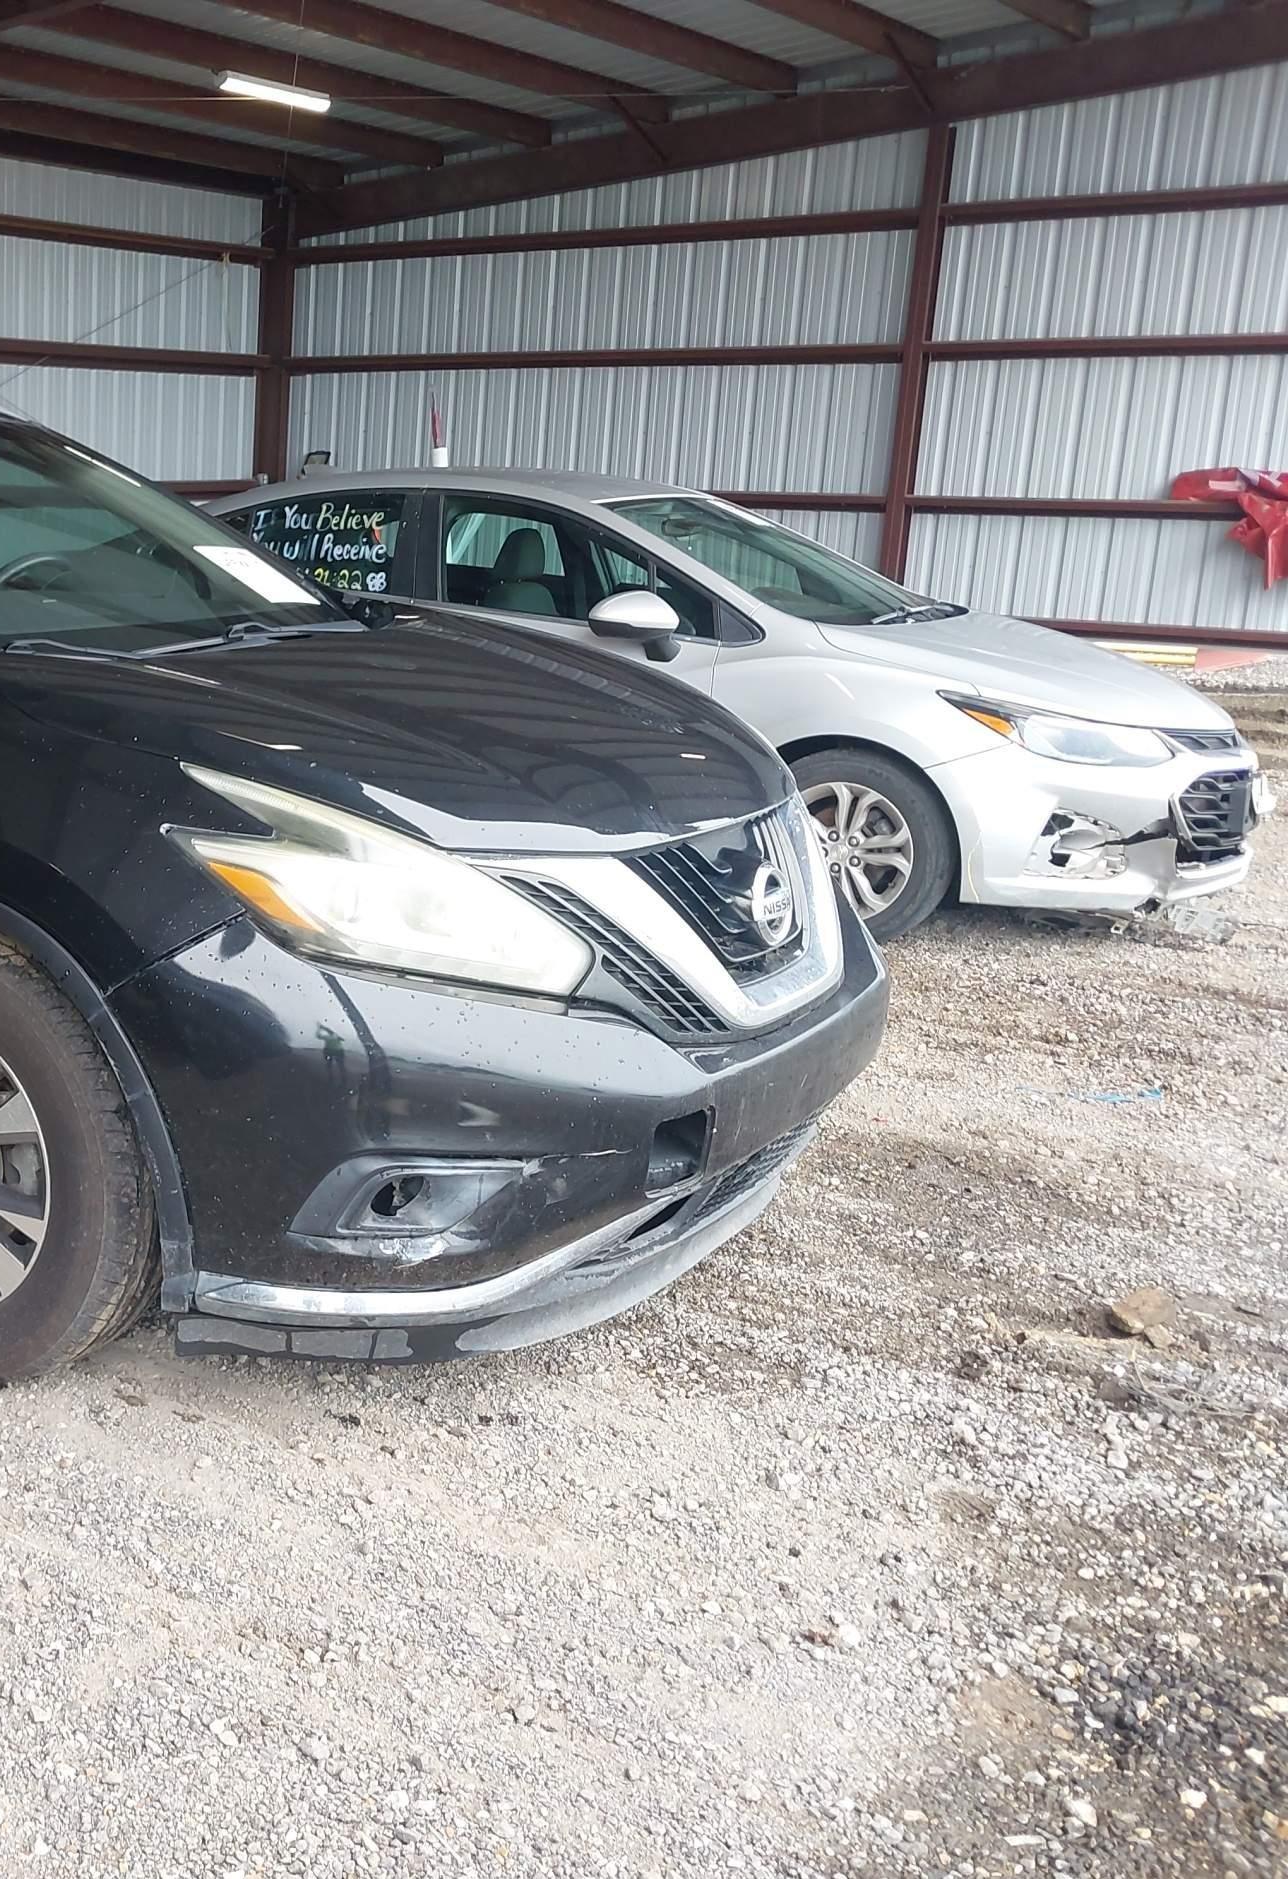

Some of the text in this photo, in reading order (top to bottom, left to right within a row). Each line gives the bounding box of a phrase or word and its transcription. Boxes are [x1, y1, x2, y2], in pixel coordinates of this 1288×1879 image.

[283, 503, 312, 529] You
[315, 502, 385, 531] Believe
[319, 532, 387, 563] Receive
